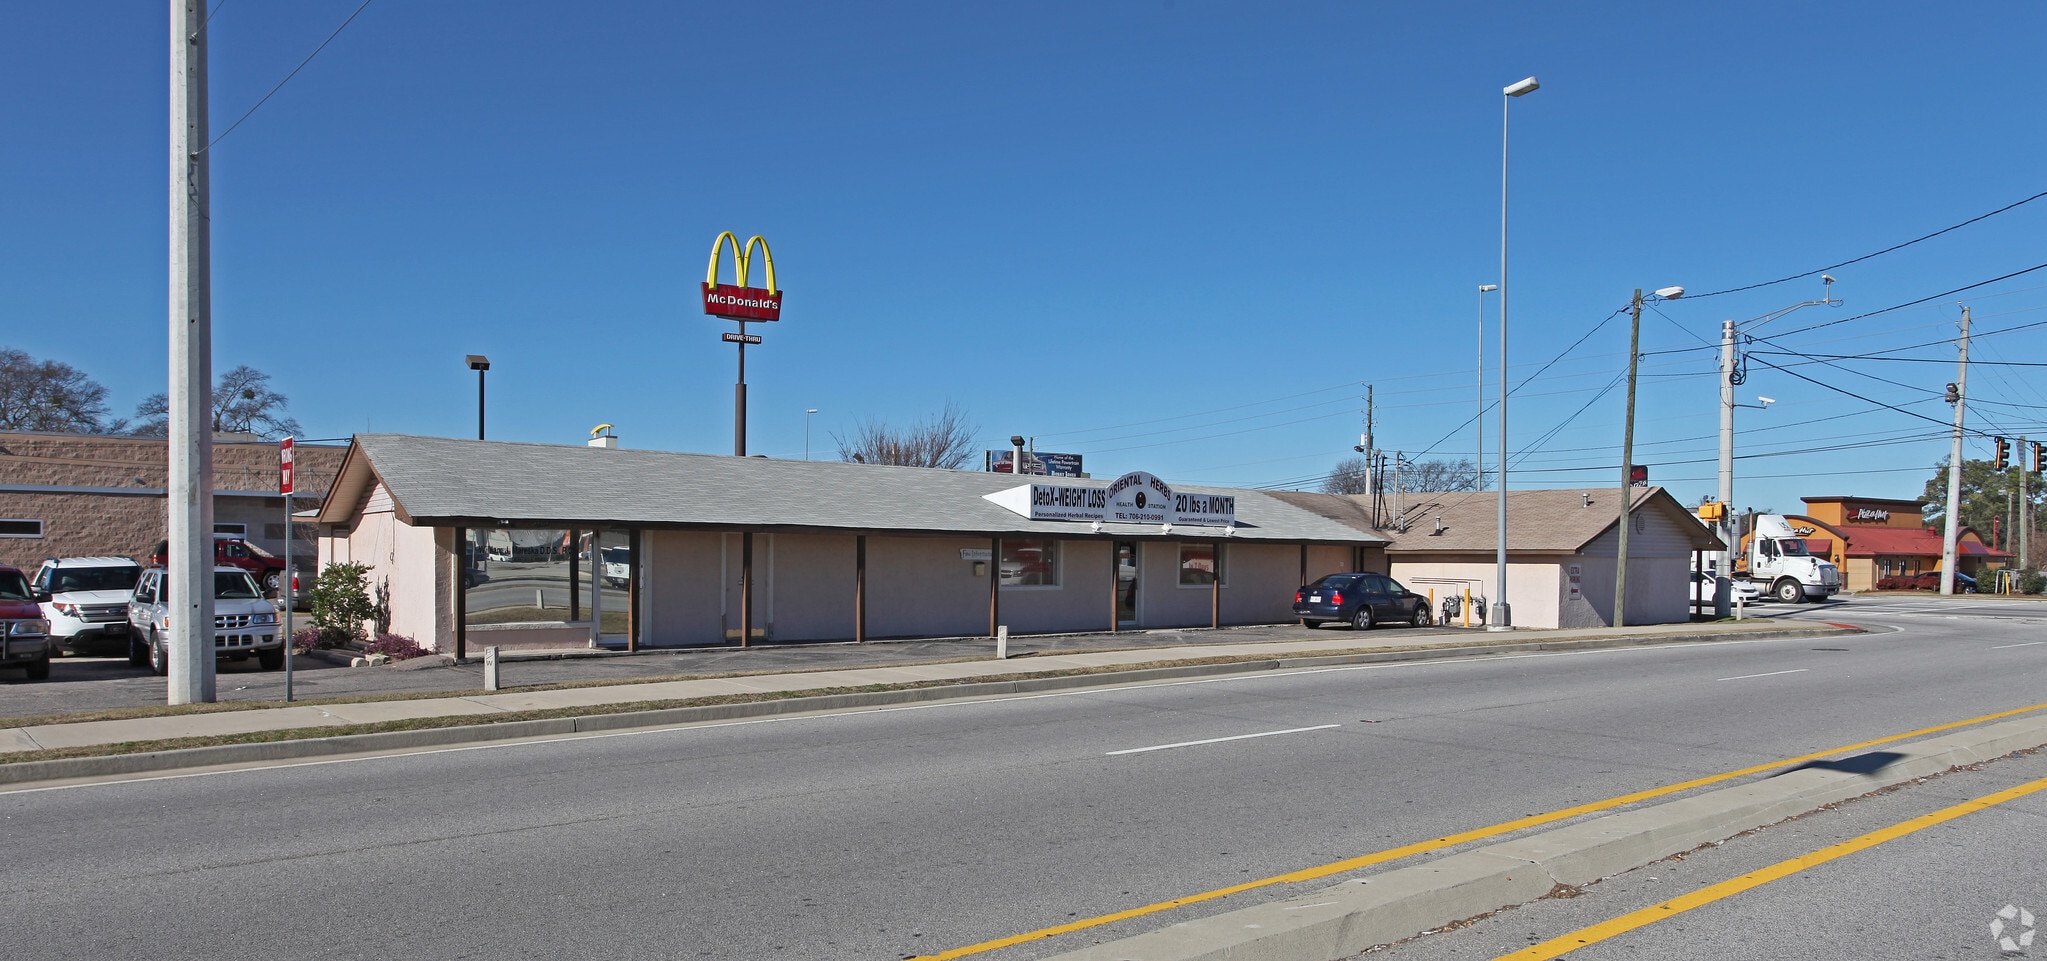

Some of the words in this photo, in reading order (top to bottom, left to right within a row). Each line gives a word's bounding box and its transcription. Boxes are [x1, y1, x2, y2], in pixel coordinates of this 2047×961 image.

[707, 293, 778, 310] McDonald's
[1108, 474, 1142, 500] ORIENTAL
[1150, 476, 1172, 502] HERBS
[1087, 489, 1106, 509] LOSS
[1175, 494, 1188, 513] 20
[1189, 495, 1201, 514] lbs
[1202, 500, 1208, 513] a
[1209, 496, 1234, 515] MONTH
[1115, 512, 1128, 520] TEL:
